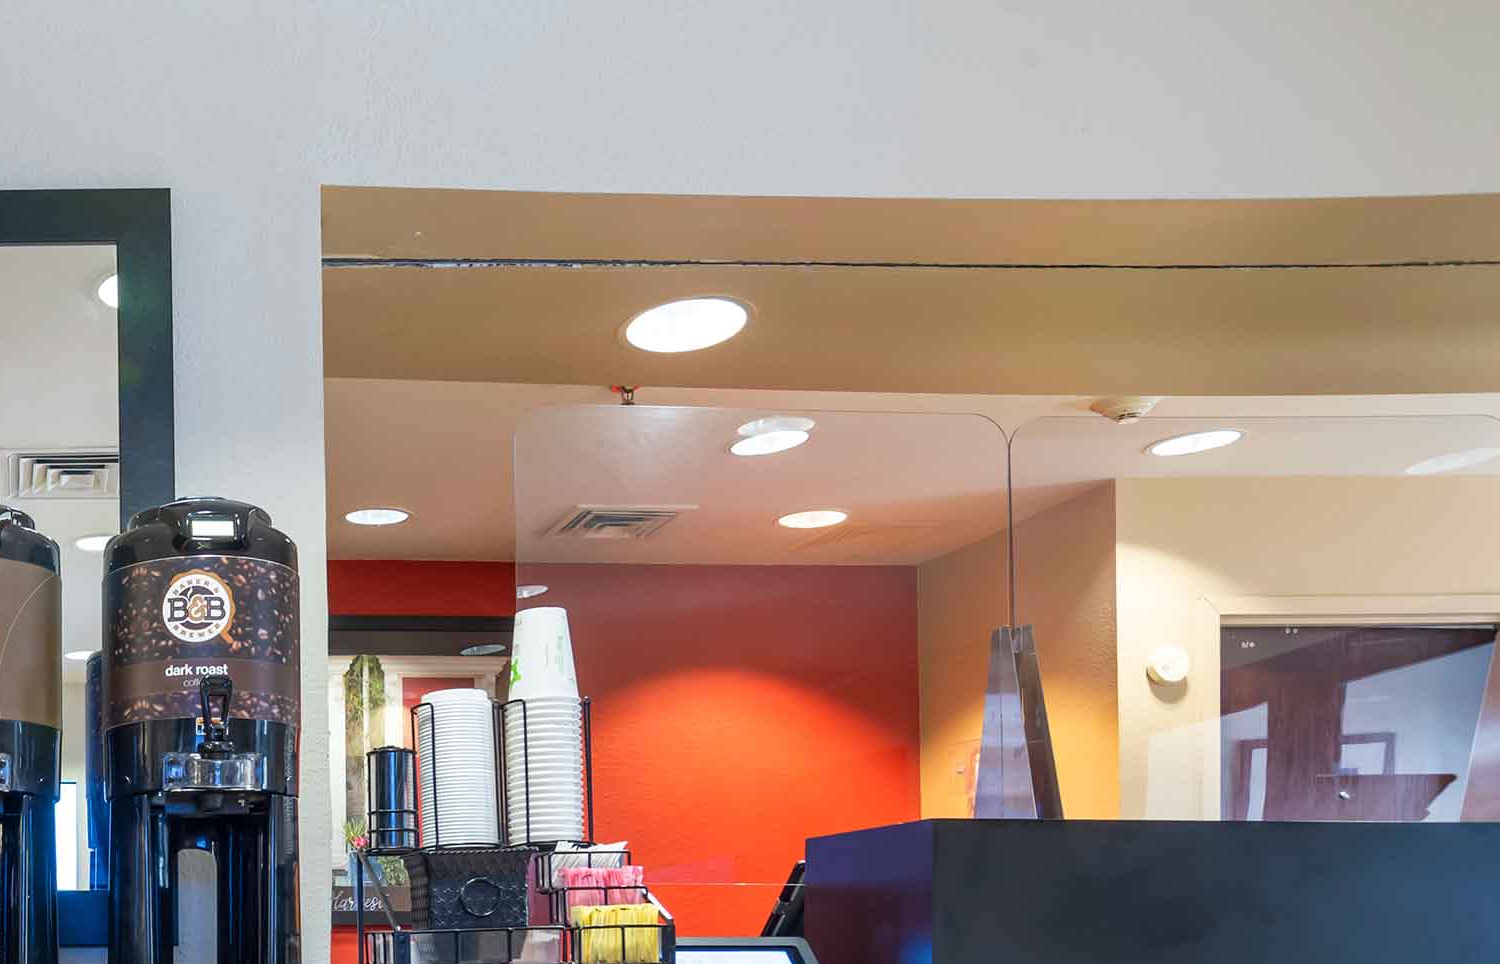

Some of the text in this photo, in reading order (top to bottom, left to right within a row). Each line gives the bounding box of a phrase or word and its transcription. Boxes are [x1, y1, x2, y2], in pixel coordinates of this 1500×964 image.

[167, 594, 227, 622] B&B
[165, 664, 228, 677] dark roast
